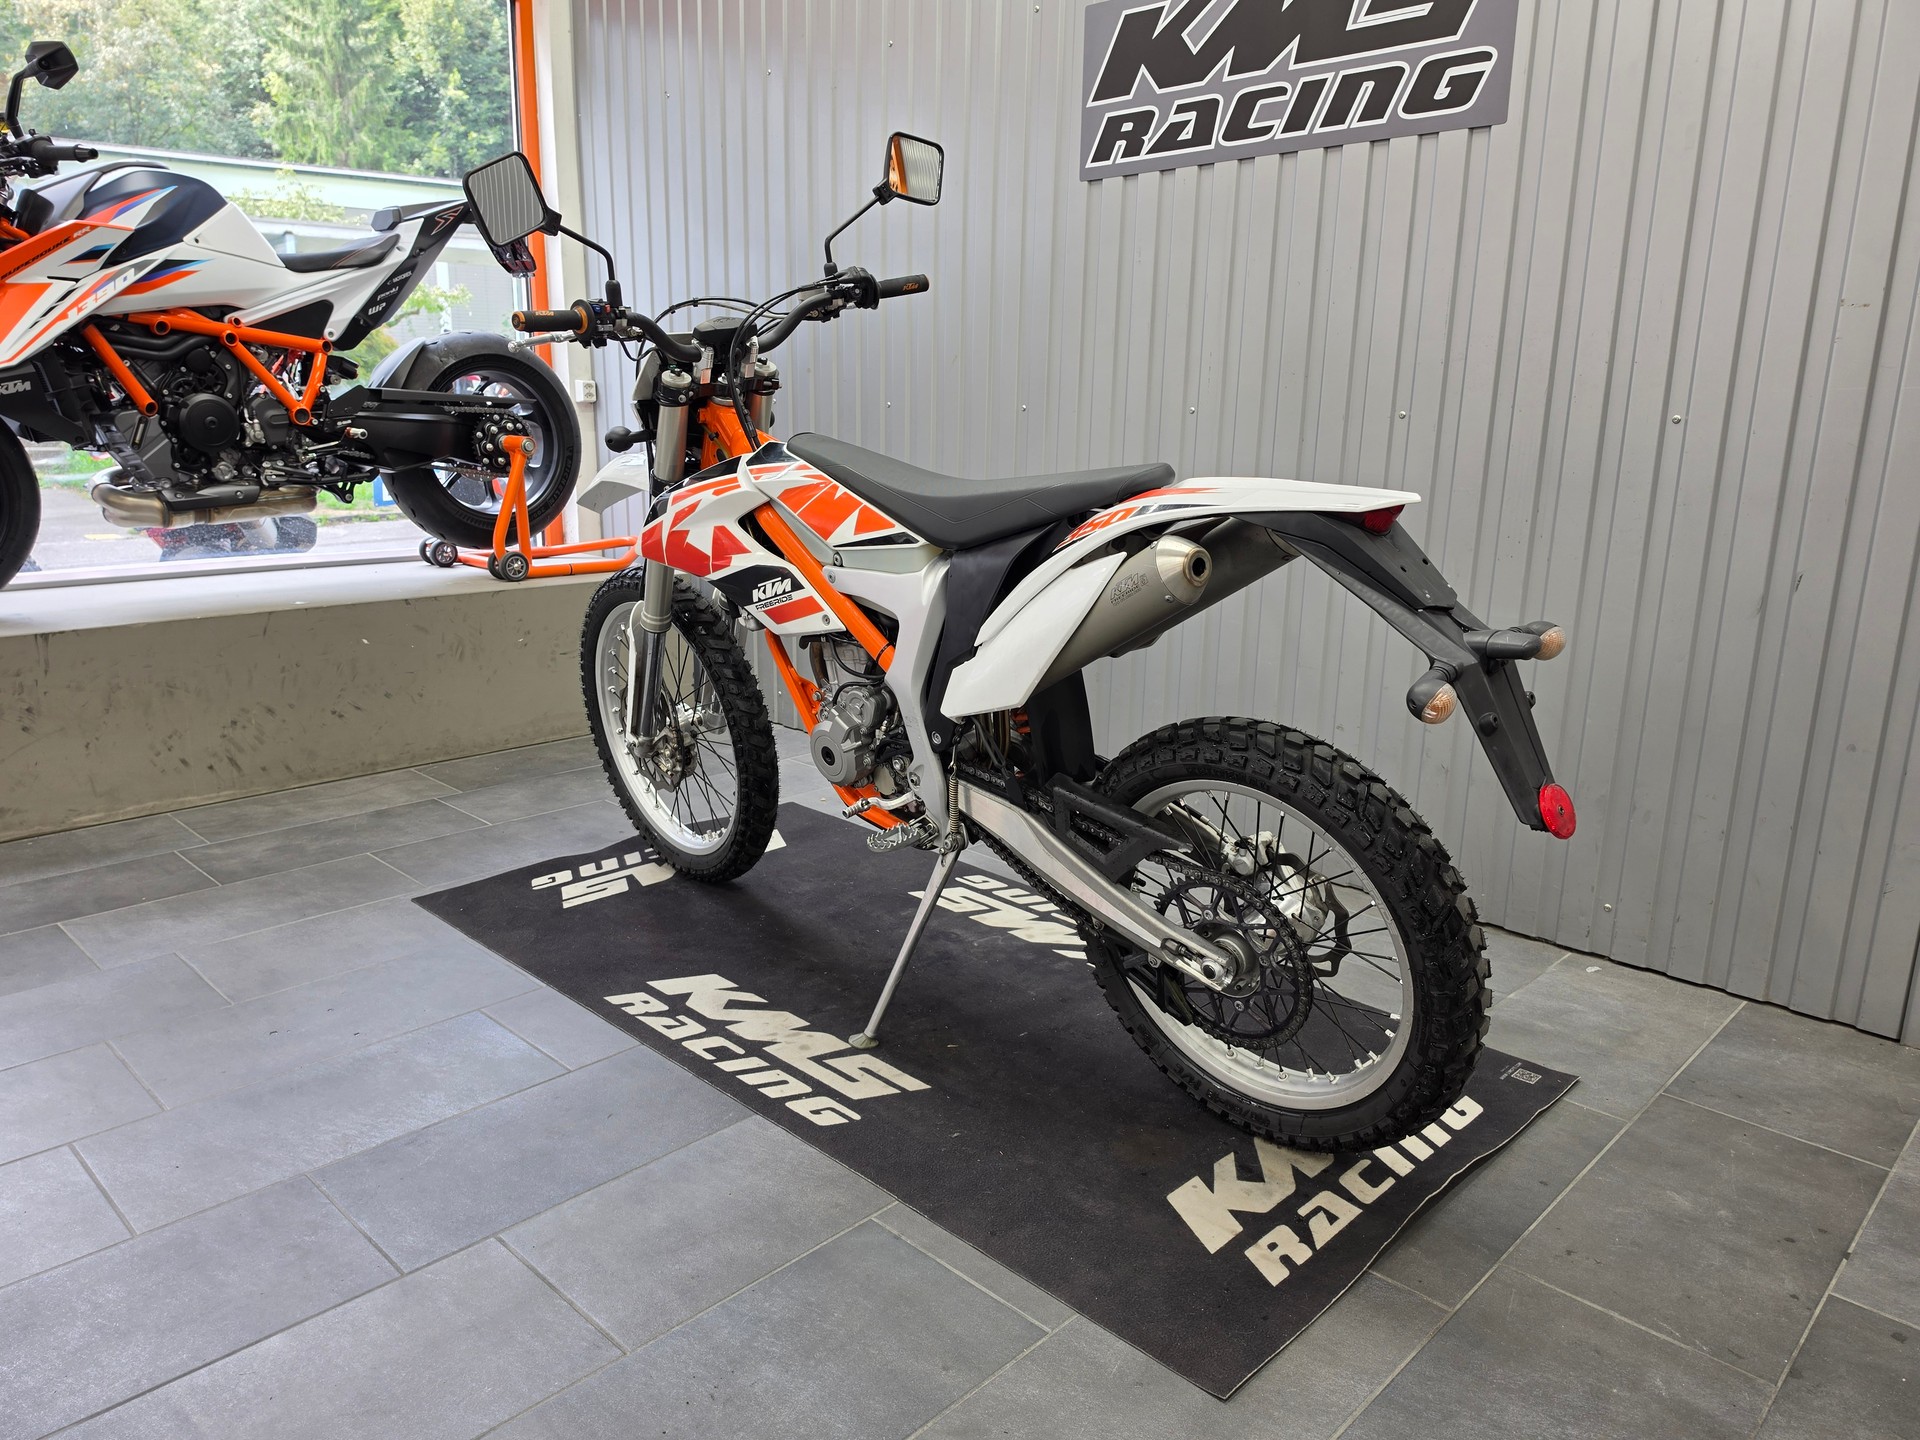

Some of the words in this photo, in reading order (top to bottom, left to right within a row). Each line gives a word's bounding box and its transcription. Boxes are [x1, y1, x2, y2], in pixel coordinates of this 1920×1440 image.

[1085, 46, 1498, 168] RACING
[902, 282, 919, 291] KTM
[368, 302, 386, 316] WP
[752, 576, 792, 603] KTM
[755, 594, 793, 610] FREERIDE
[646, 973, 932, 1100] KMS
[603, 991, 862, 1126] RACING
